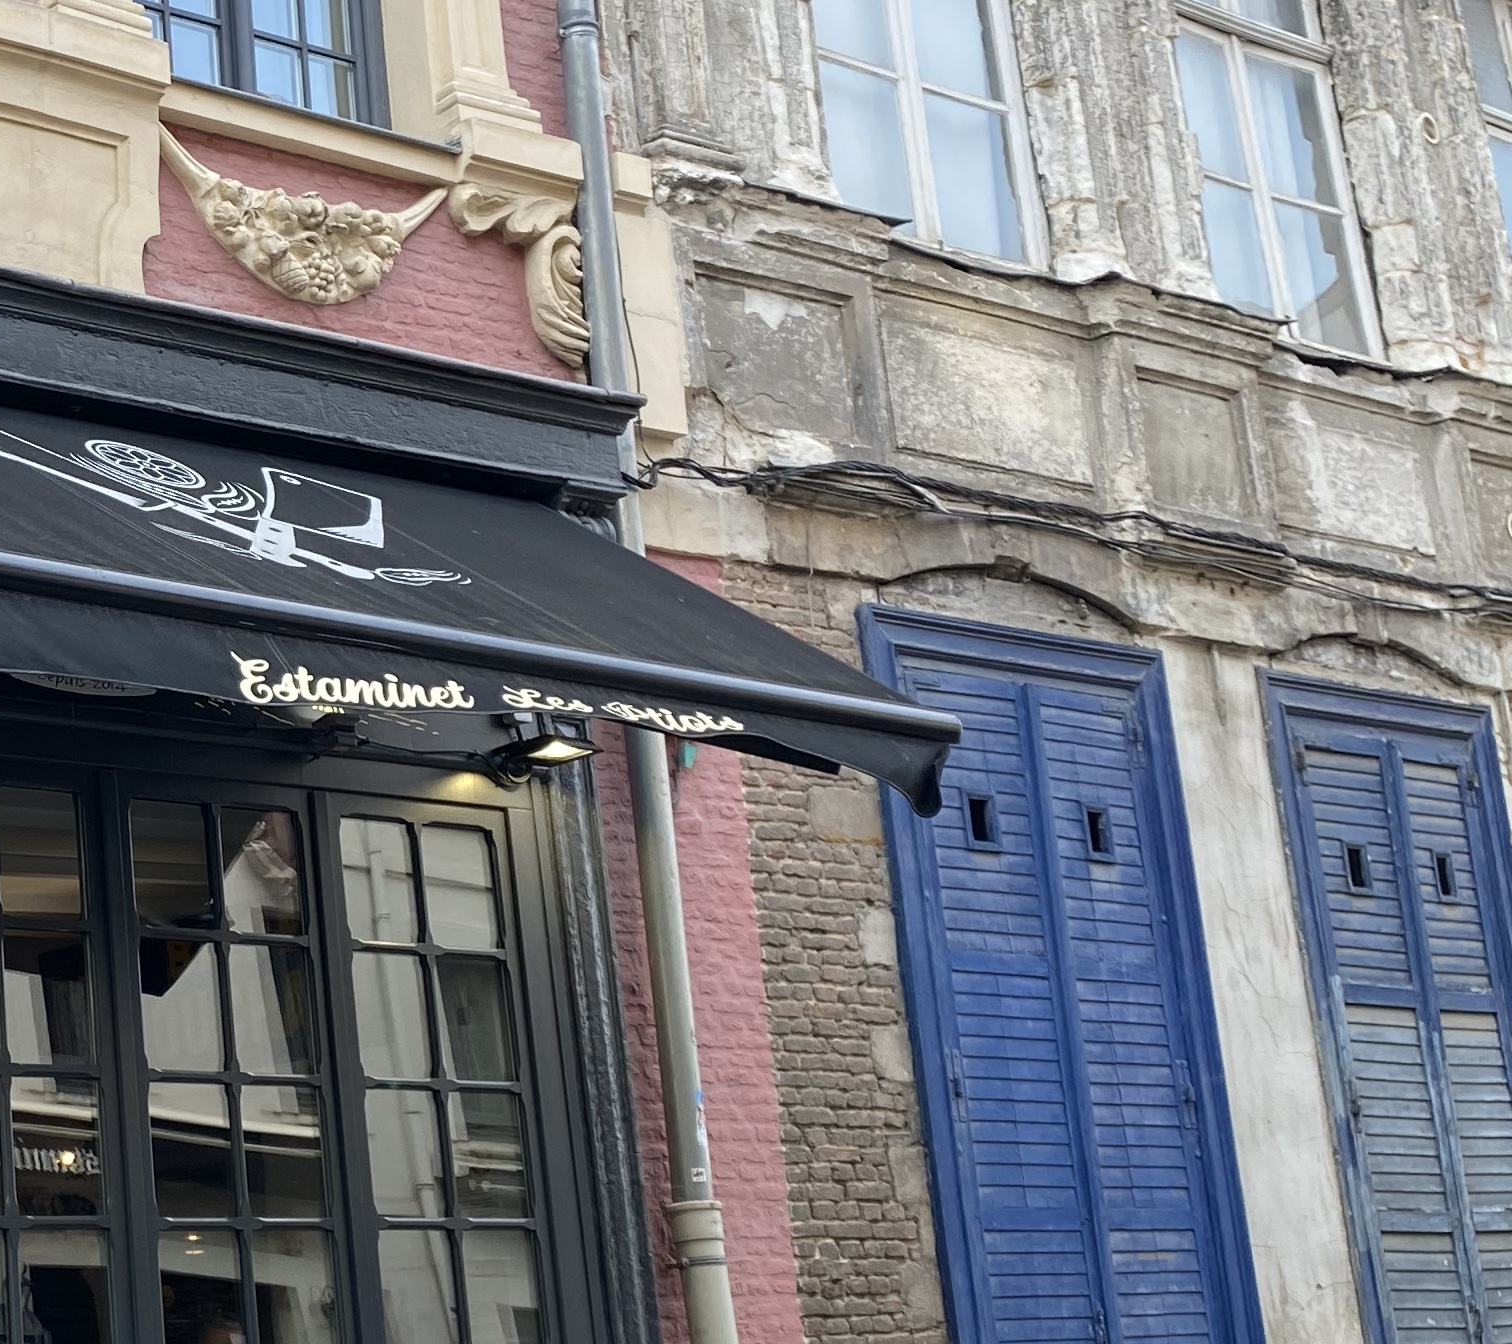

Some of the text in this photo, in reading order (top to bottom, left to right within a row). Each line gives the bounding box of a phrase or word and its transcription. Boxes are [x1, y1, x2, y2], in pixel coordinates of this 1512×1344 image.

[230, 651, 475, 709] Estaminet
[502, 685, 745, 734] Les Ptiots
